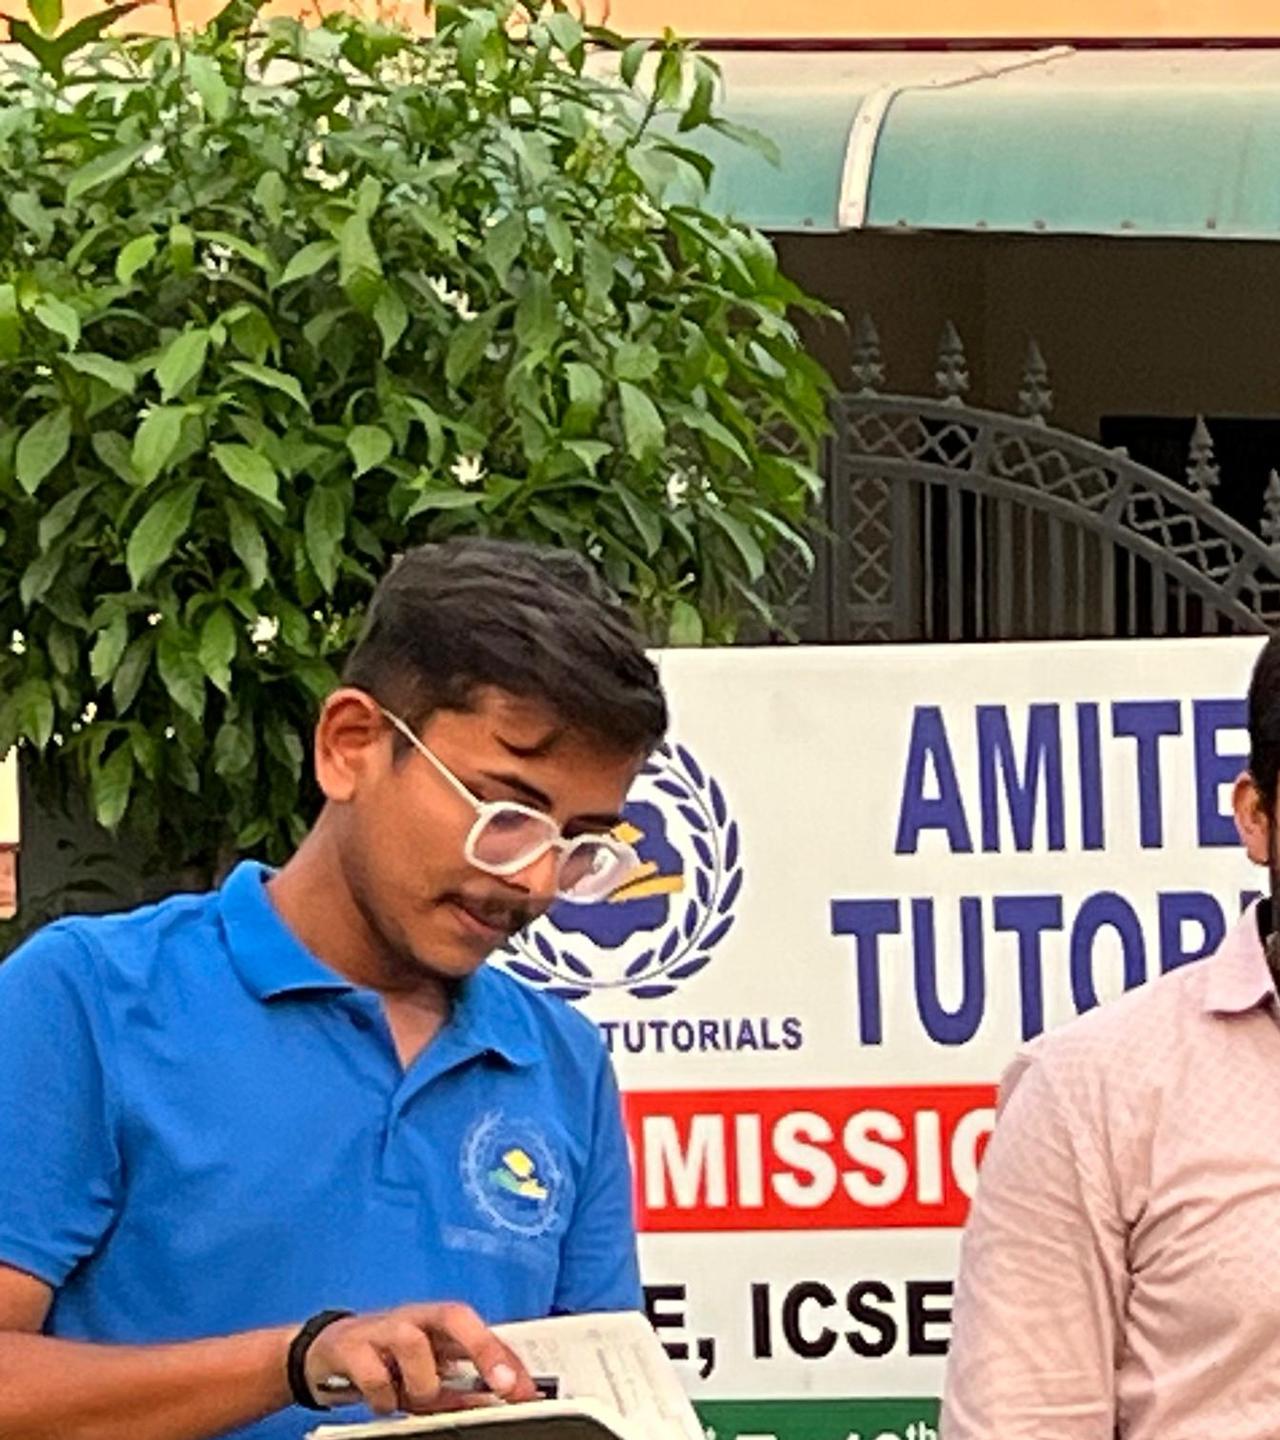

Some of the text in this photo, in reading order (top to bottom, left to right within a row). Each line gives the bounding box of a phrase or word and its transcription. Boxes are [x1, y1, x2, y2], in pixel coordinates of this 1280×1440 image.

[831, 889, 1262, 1049] TUTOR
[600, 1017, 803, 1053] TUTORIALS
[751, 1280, 954, 1360] ICSE
